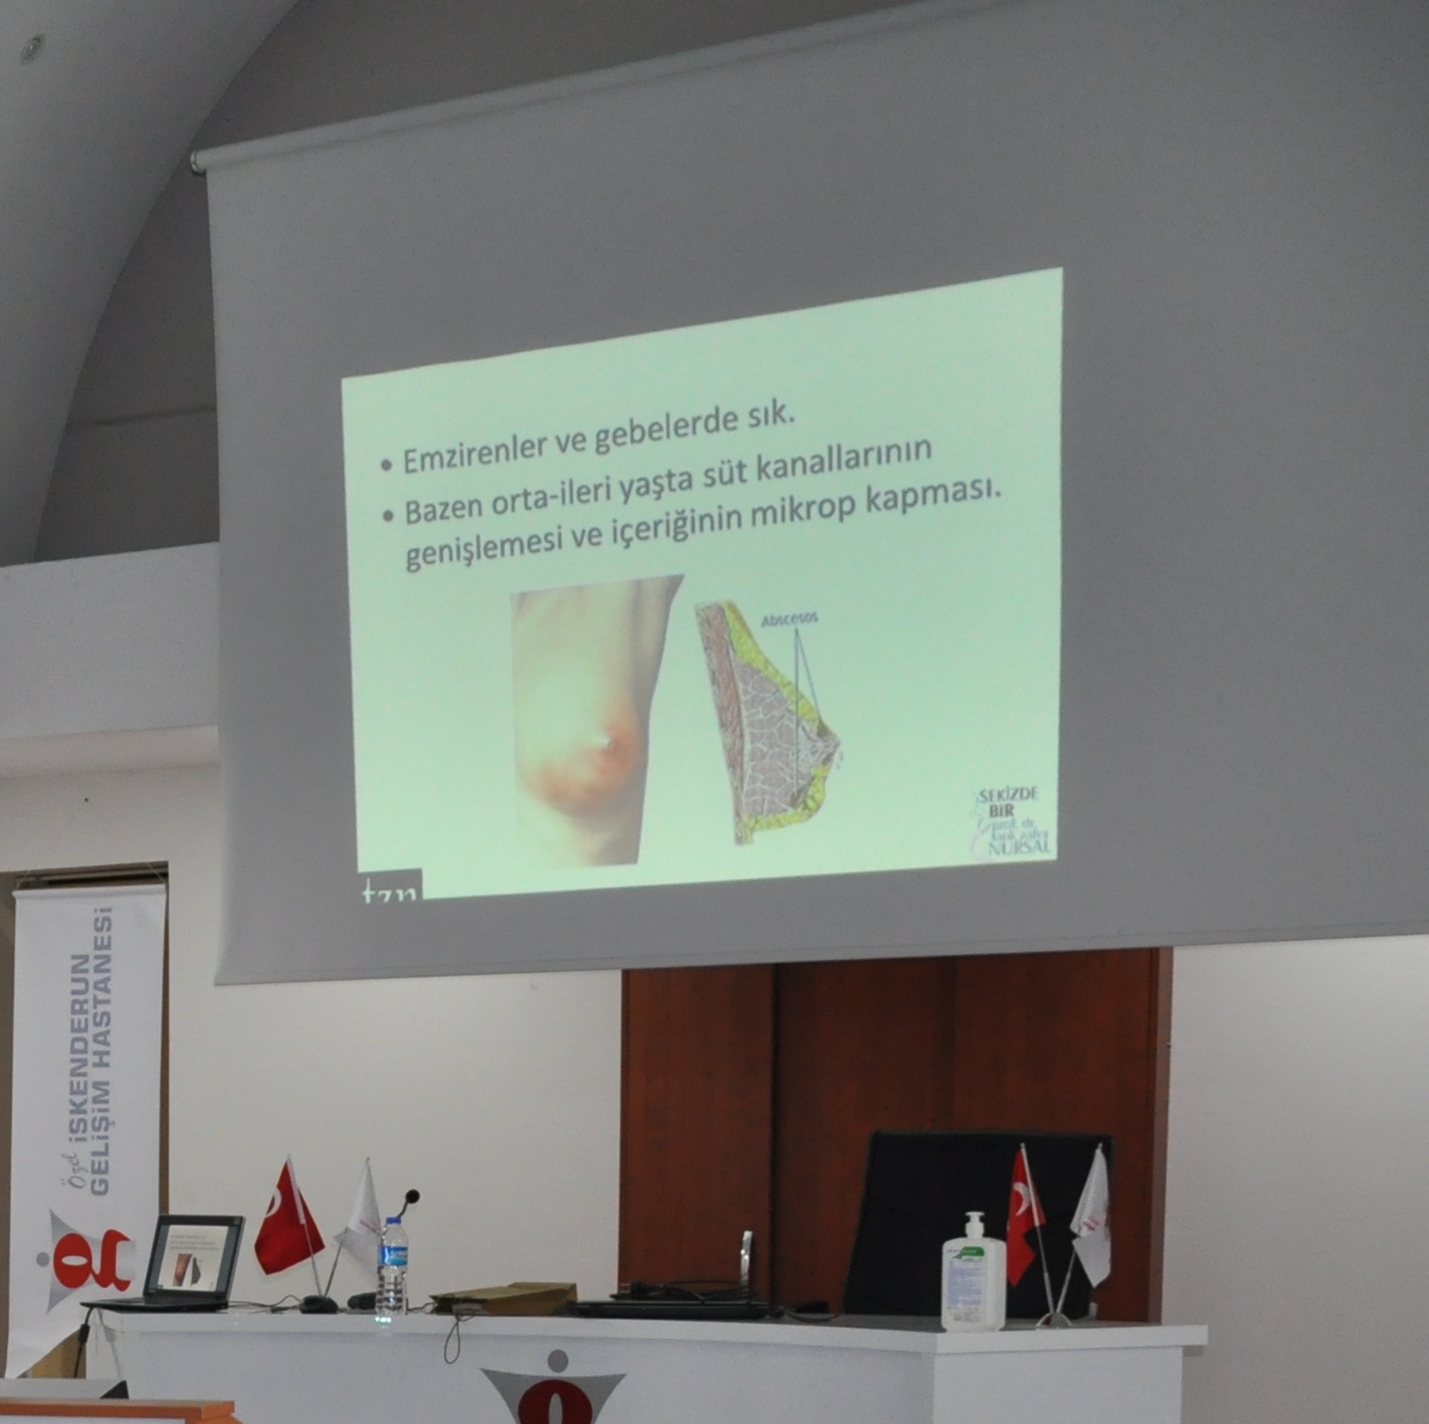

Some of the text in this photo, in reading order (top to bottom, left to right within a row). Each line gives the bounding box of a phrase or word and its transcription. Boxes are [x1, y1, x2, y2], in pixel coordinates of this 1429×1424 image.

[403, 397, 795, 475] Emzirenler ve gebelerde sık.
[405, 438, 932, 525] Bazen orta-ileri yaşta süt kanallarının
[405, 477, 1001, 574] genişlemesi ve içeriğinin mikrop kapması.
